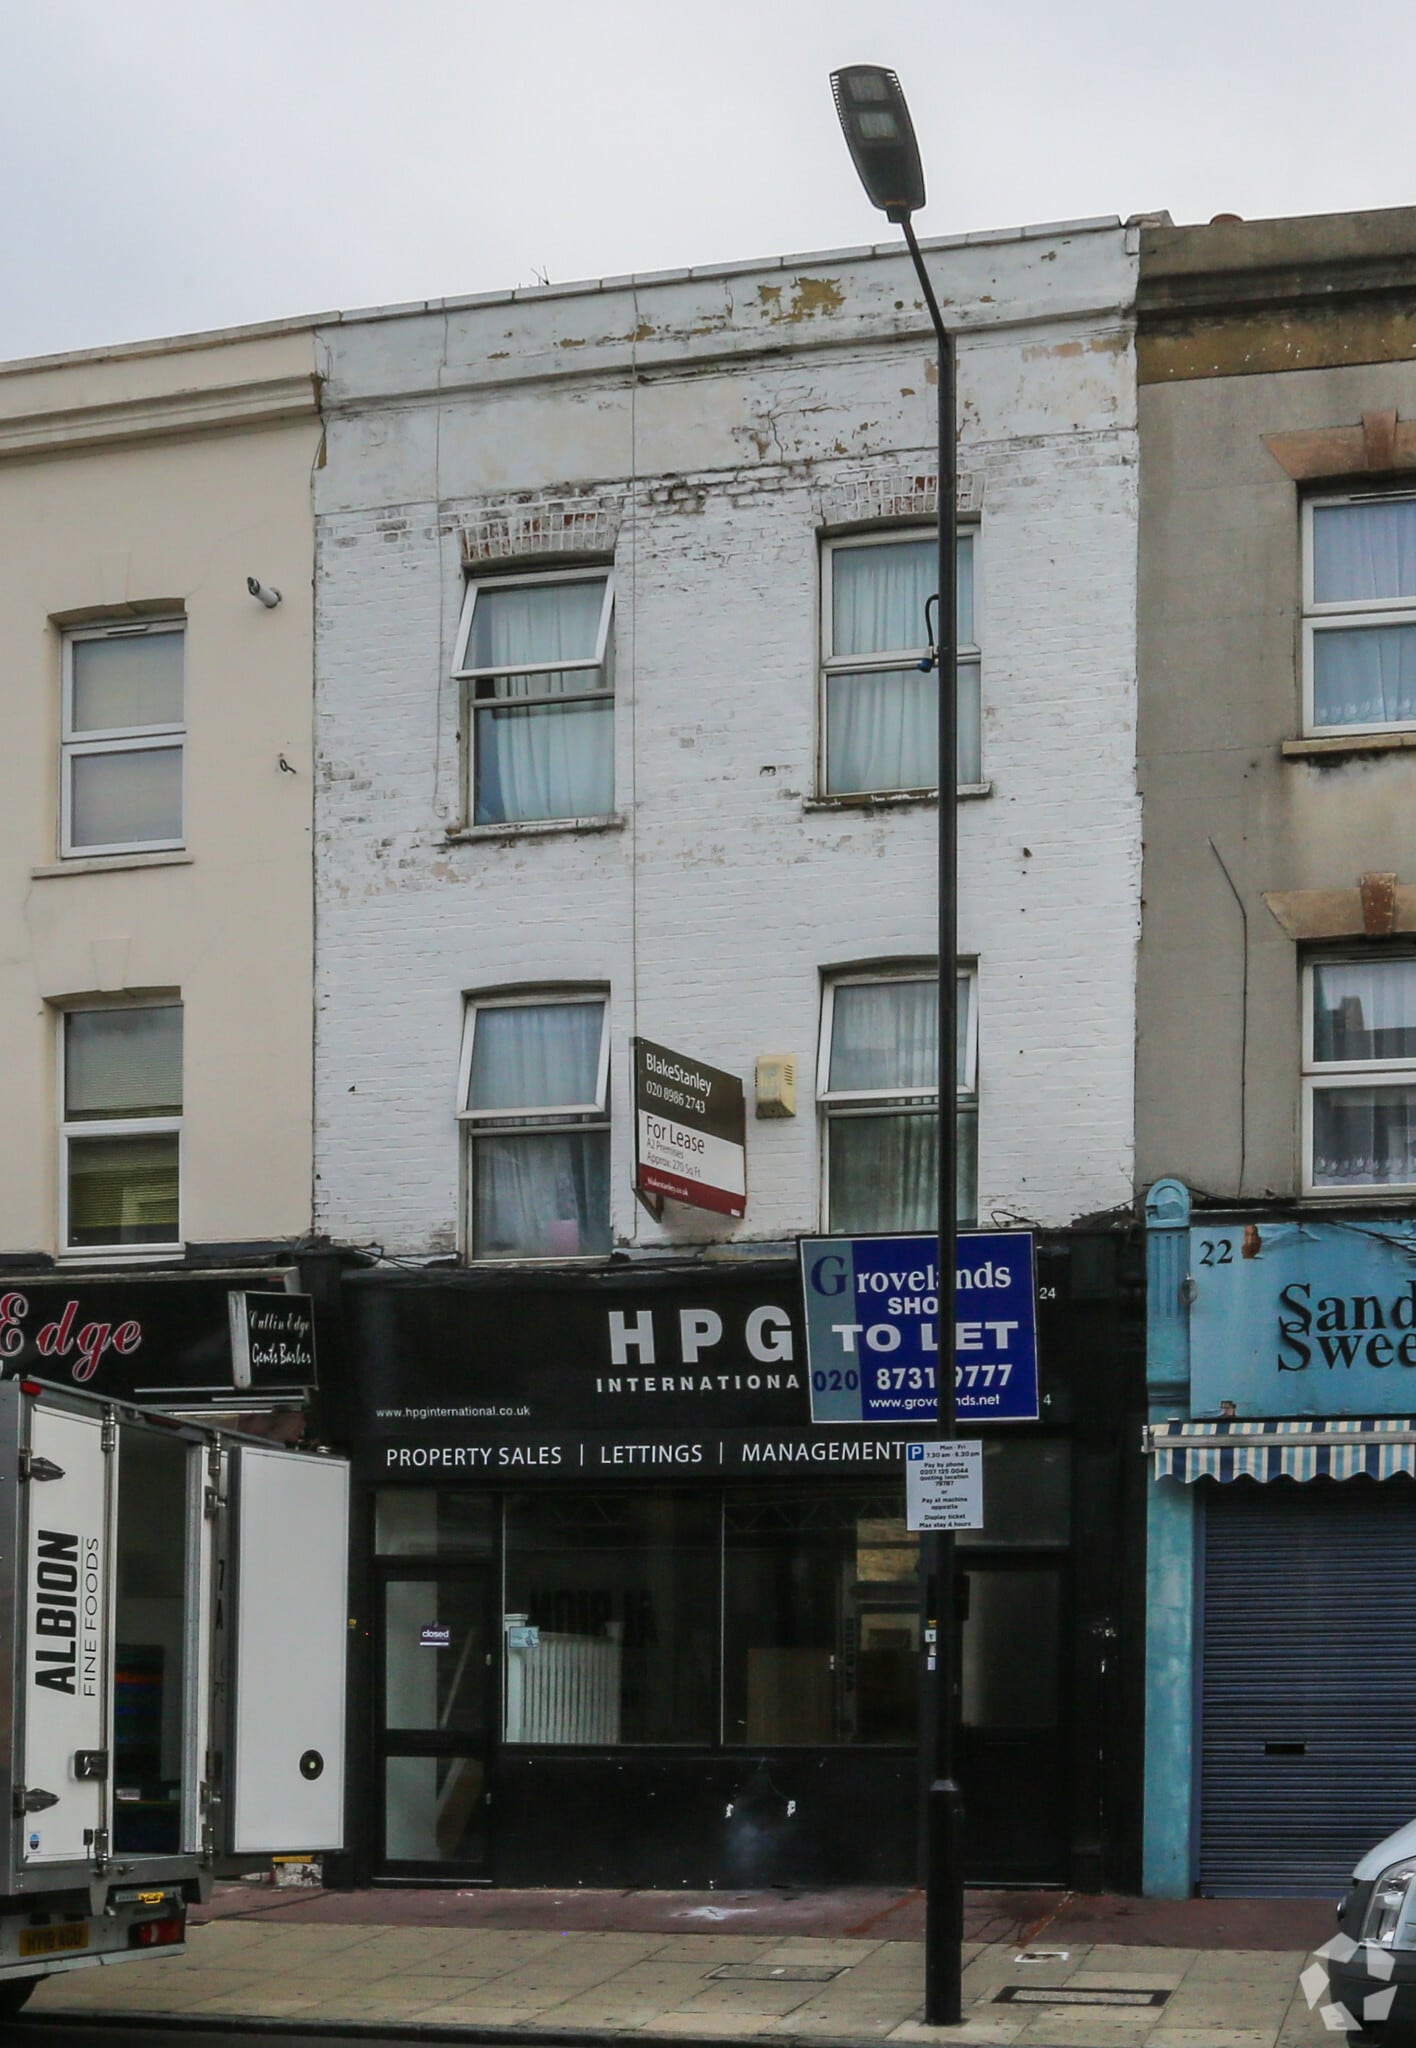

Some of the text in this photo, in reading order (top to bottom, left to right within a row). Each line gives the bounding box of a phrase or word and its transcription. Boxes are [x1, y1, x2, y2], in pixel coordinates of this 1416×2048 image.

[646, 1053, 712, 1097] BlakeStanley
[646, 1081, 706, 1114] 020 8986 2743
[646, 1115, 705, 1154] For Lease
[656, 1140, 684, 1159] Premises
[1199, 1239, 1233, 1267] 22
[811, 1255, 1011, 1297] Grovelnds
[887, 1297, 939, 1315] SHO
[1040, 1287, 1056, 1300] 24
[0, 1293, 141, 1382] Edge
[831, 1321, 1019, 1352] TO LET
[252, 1343, 311, 1367] Gents Barber
[596, 1374, 800, 1393] INTERNATIONA
[813, 1369, 859, 1392] 020
[876, 1367, 936, 1391] 8731
[376, 1405, 531, 1419] www.hpginternational.co.uk
[386, 1441, 905, 1467] PROPERTY SALES LETTINGS MANAGEMENT
[35, 1529, 79, 1695] ALBION
[84, 1537, 99, 1696] FINE FOODS
[422, 1629, 449, 1638] closed
